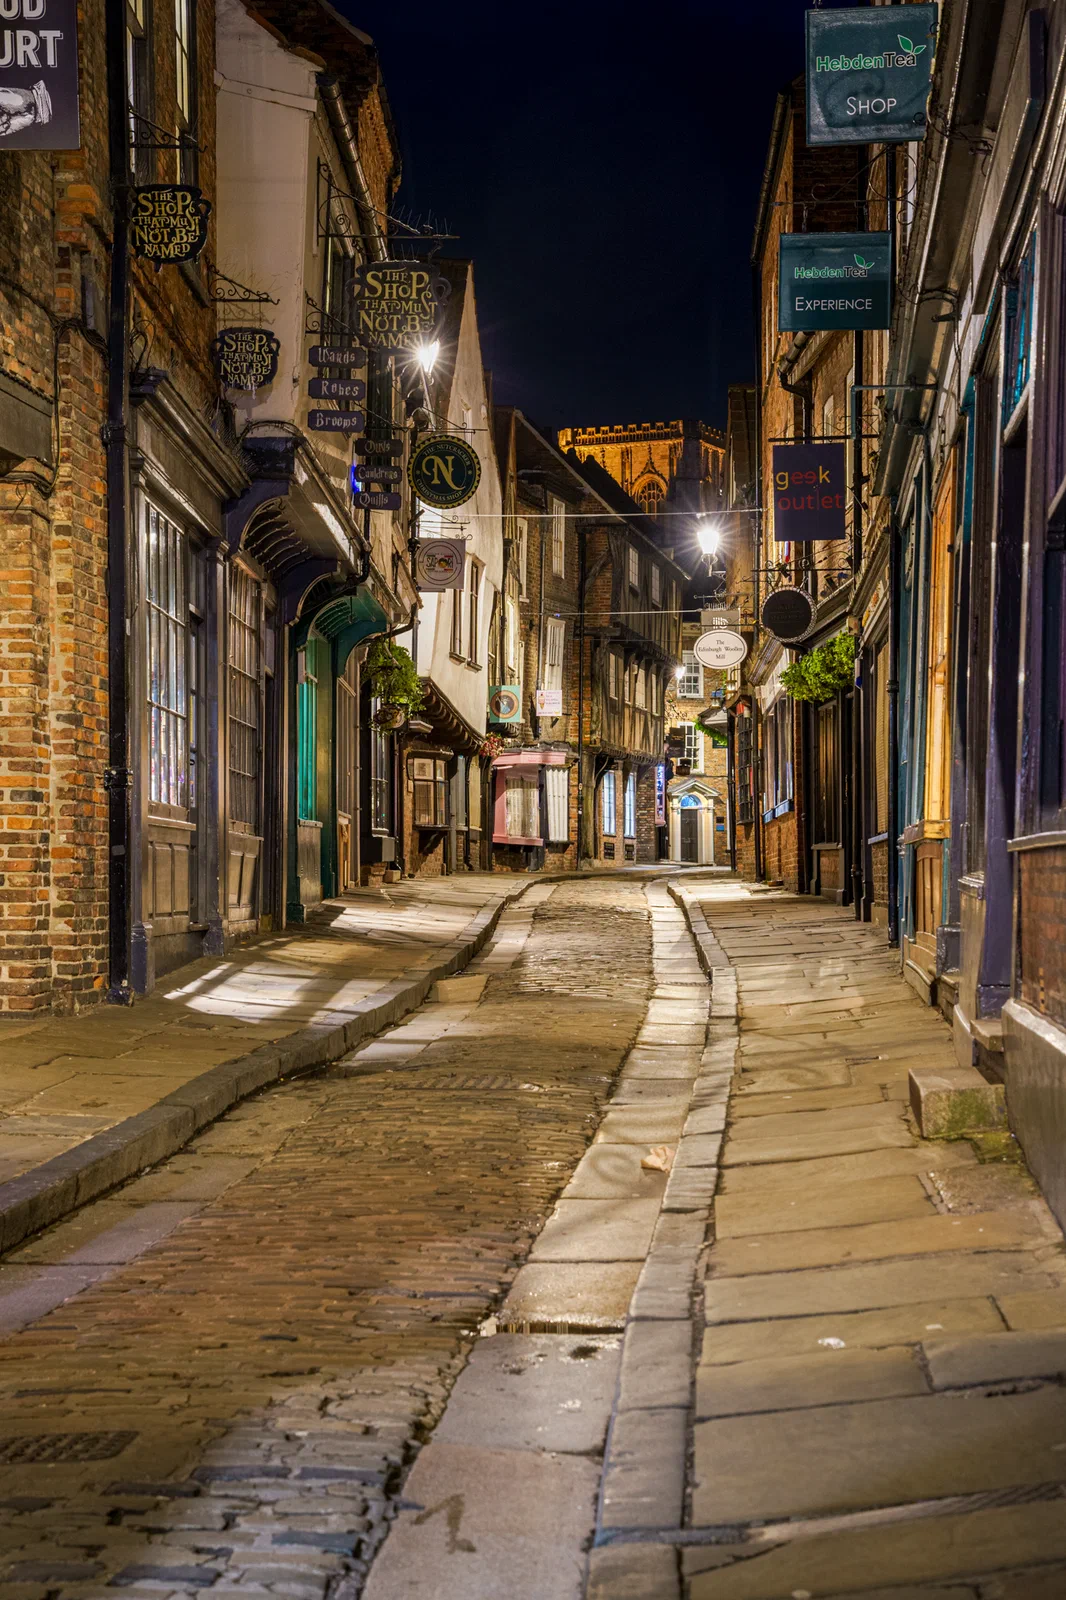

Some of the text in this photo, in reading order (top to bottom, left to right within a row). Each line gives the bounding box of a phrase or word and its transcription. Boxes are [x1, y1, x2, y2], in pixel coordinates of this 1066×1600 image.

[816, 51, 917, 72] HebdenTea
[137, 191, 192, 216] SHOP
[152, 188, 177, 202] THE
[132, 216, 169, 229] THAT
[135, 225, 199, 247] NOT BE
[144, 243, 191, 259] NAMED
[382, 266, 411, 284] THE
[794, 265, 868, 279] HebdenTea
[364, 270, 429, 300] SHOP
[356, 299, 401, 314] THAT
[358, 309, 433, 334] NOT BE
[223, 333, 267, 353] SHOP
[234, 332, 254, 343] THE
[219, 351, 249, 362] THAT
[318, 347, 356, 365] Wands
[220, 359, 271, 376] NOT BE
[227, 373, 264, 387] NAMED
[321, 380, 360, 397] Robes
[315, 412, 358, 429] Brooms
[423, 446, 436, 457] THE
[775, 465, 832, 492] geek
[446, 490, 464, 501] SHOP
[776, 492, 845, 512] outlet
